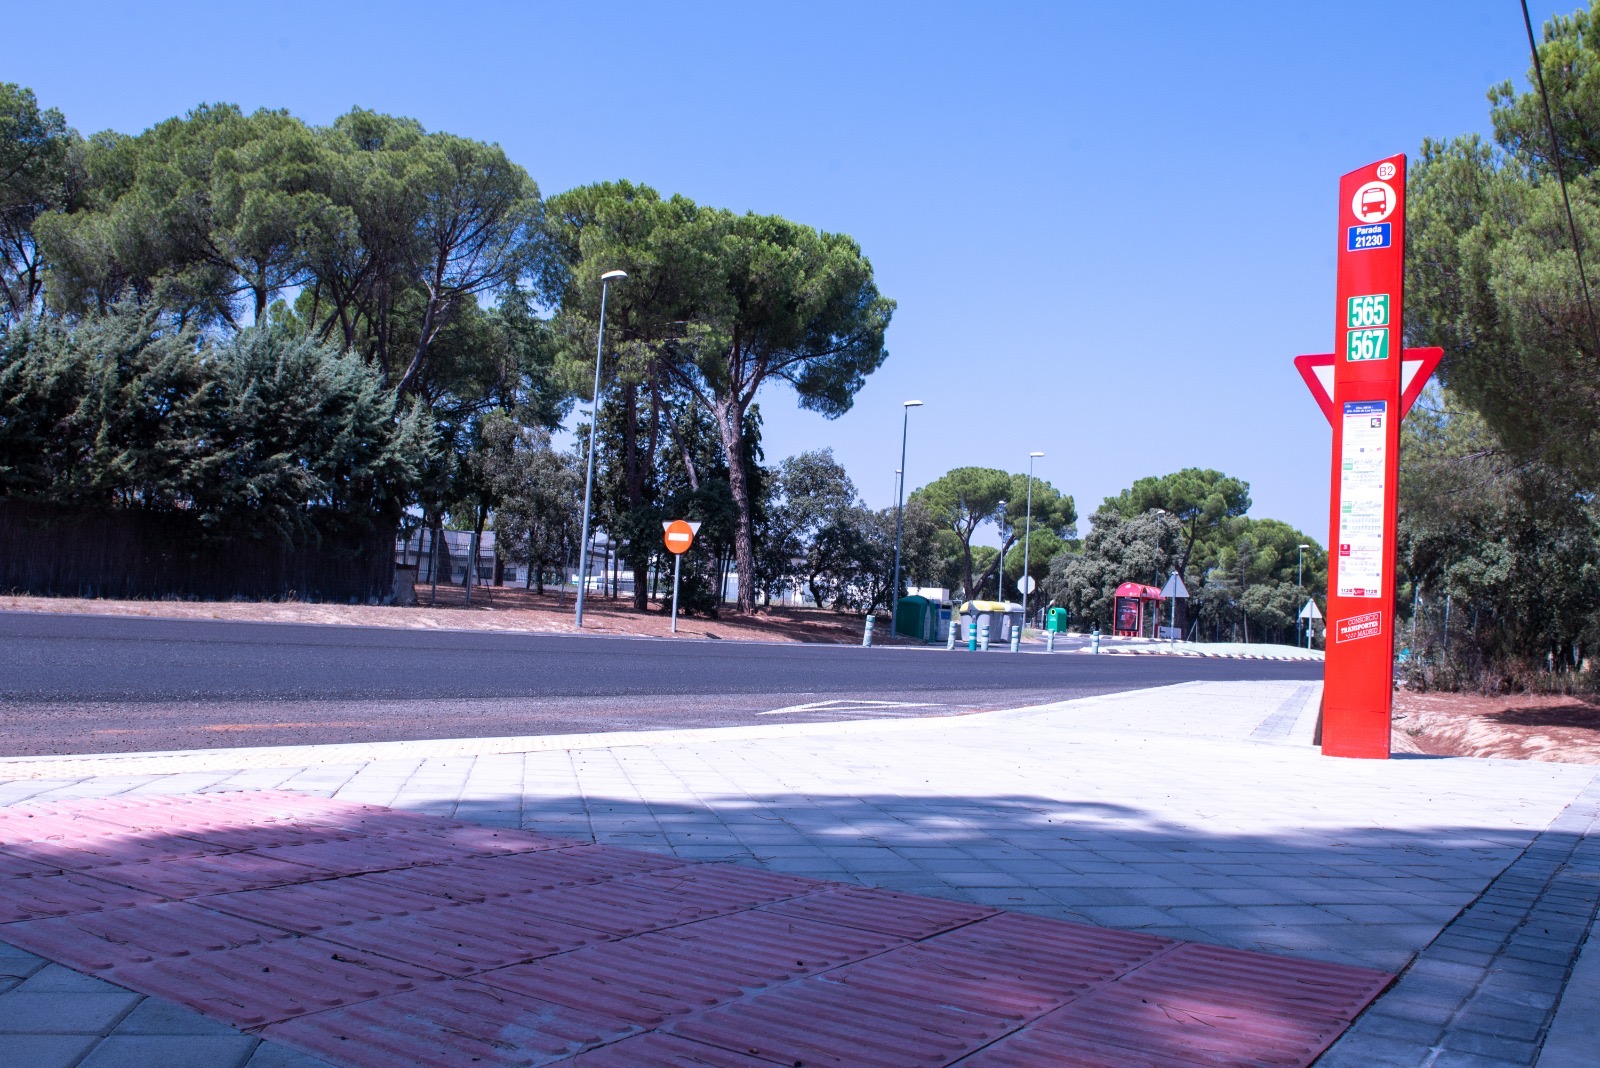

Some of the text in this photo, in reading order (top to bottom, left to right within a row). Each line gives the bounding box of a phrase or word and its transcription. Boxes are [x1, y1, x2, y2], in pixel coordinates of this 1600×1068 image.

[1379, 166, 1394, 177] B2
[1356, 225, 1382, 235] Parada
[1355, 234, 1383, 248] 21230
[1352, 296, 1385, 327] 565
[1351, 330, 1385, 360] 567
[1347, 613, 1379, 626] CONSORCIO
[1340, 620, 1379, 634] TRANSPORTES
[1357, 627, 1379, 638] MADRID
